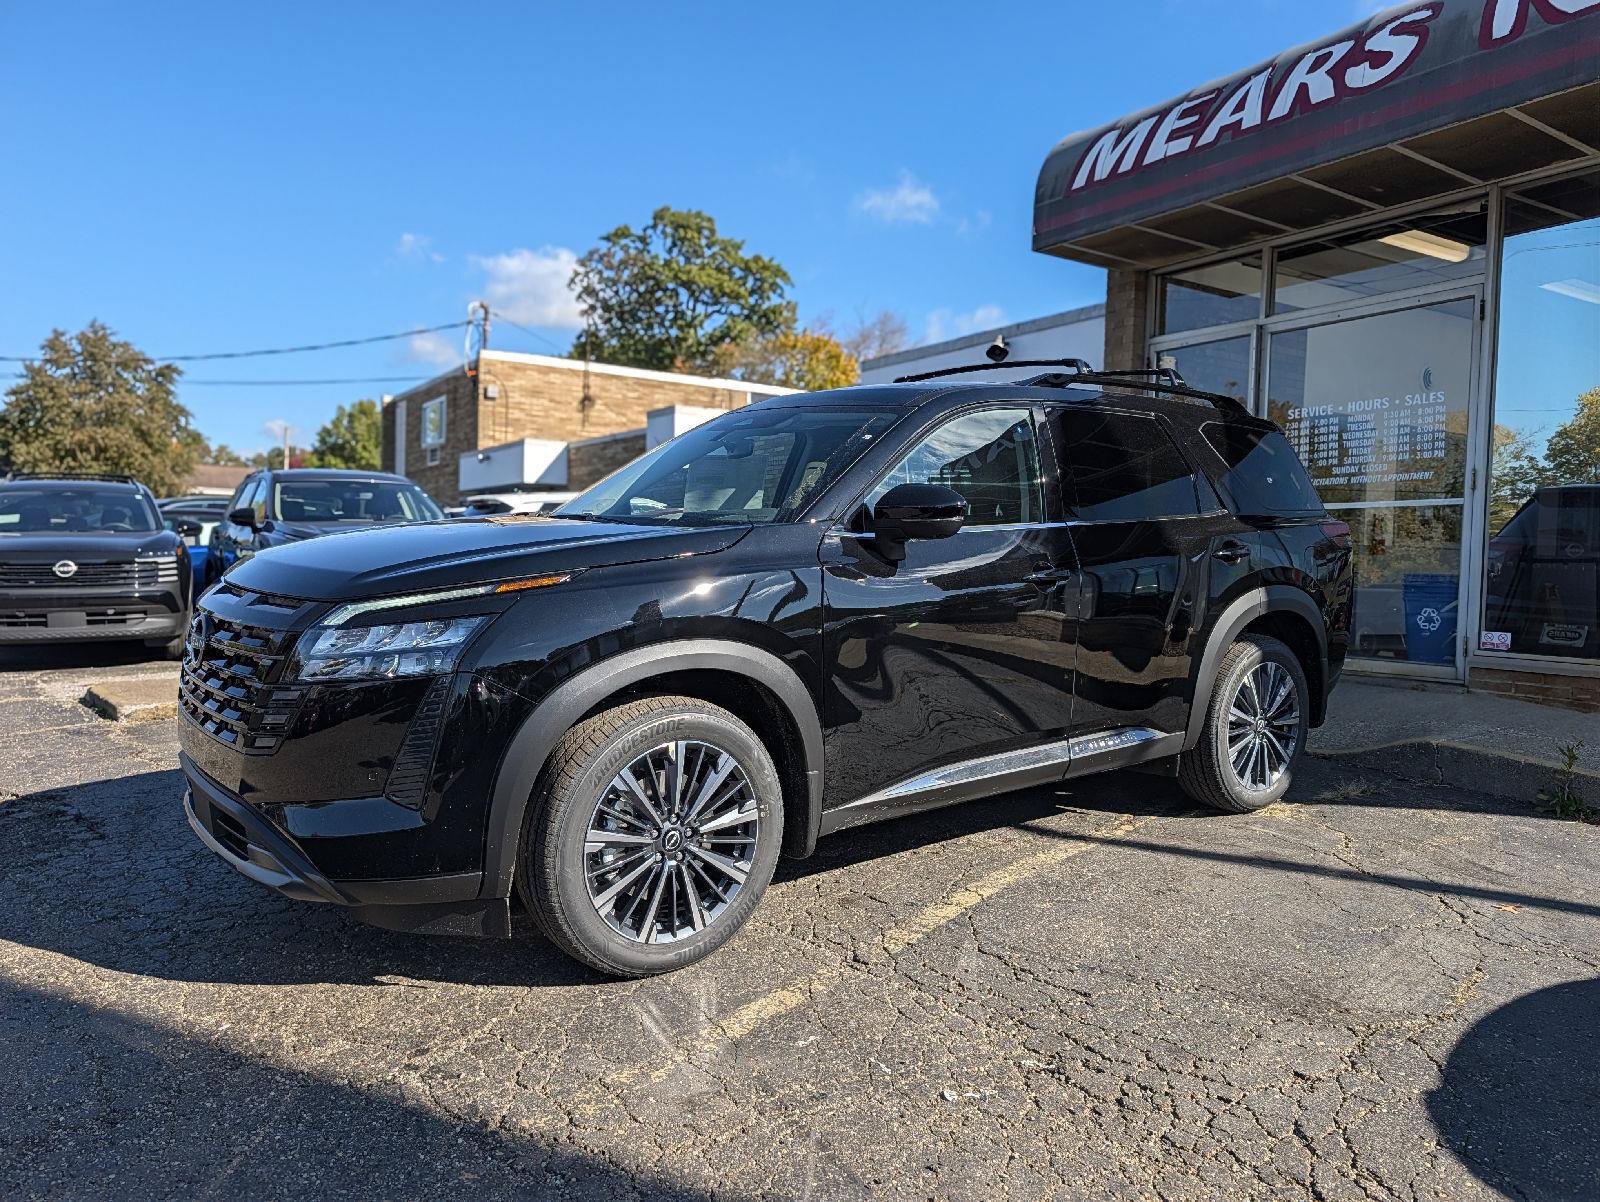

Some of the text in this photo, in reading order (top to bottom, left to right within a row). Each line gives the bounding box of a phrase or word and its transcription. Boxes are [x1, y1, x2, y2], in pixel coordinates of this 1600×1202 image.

[1070, 6, 1437, 192] MEARS
[1287, 391, 1445, 420] SERVICE HOURS SALES
[1400, 409, 1410, 417] AM
[1435, 405, 1446, 413] PM
[1347, 413, 1375, 423] MONDAY
[1346, 422, 1375, 430] TUESDAY
[1399, 426, 1410, 434] AM
[1342, 429, 1379, 440] WEDNESDAY
[1398, 435, 1409, 443] AM
[1435, 432, 1446, 440] PM
[1342, 438, 1376, 448] THURSDAY
[1382, 445, 1398, 453] 9:00
[1398, 443, 1409, 451] AM
[1434, 440, 1445, 448] PM
[1348, 447, 1371, 456] FRIDAY
[1398, 452, 1409, 460] AM
[1343, 455, 1377, 465] SATURDAY
[1331, 462, 1388, 475] SUNDAY CLOSED
[1350, 475, 1382, 485] WITHOUT
[1382, 471, 1435, 482] APPOINTMENT
